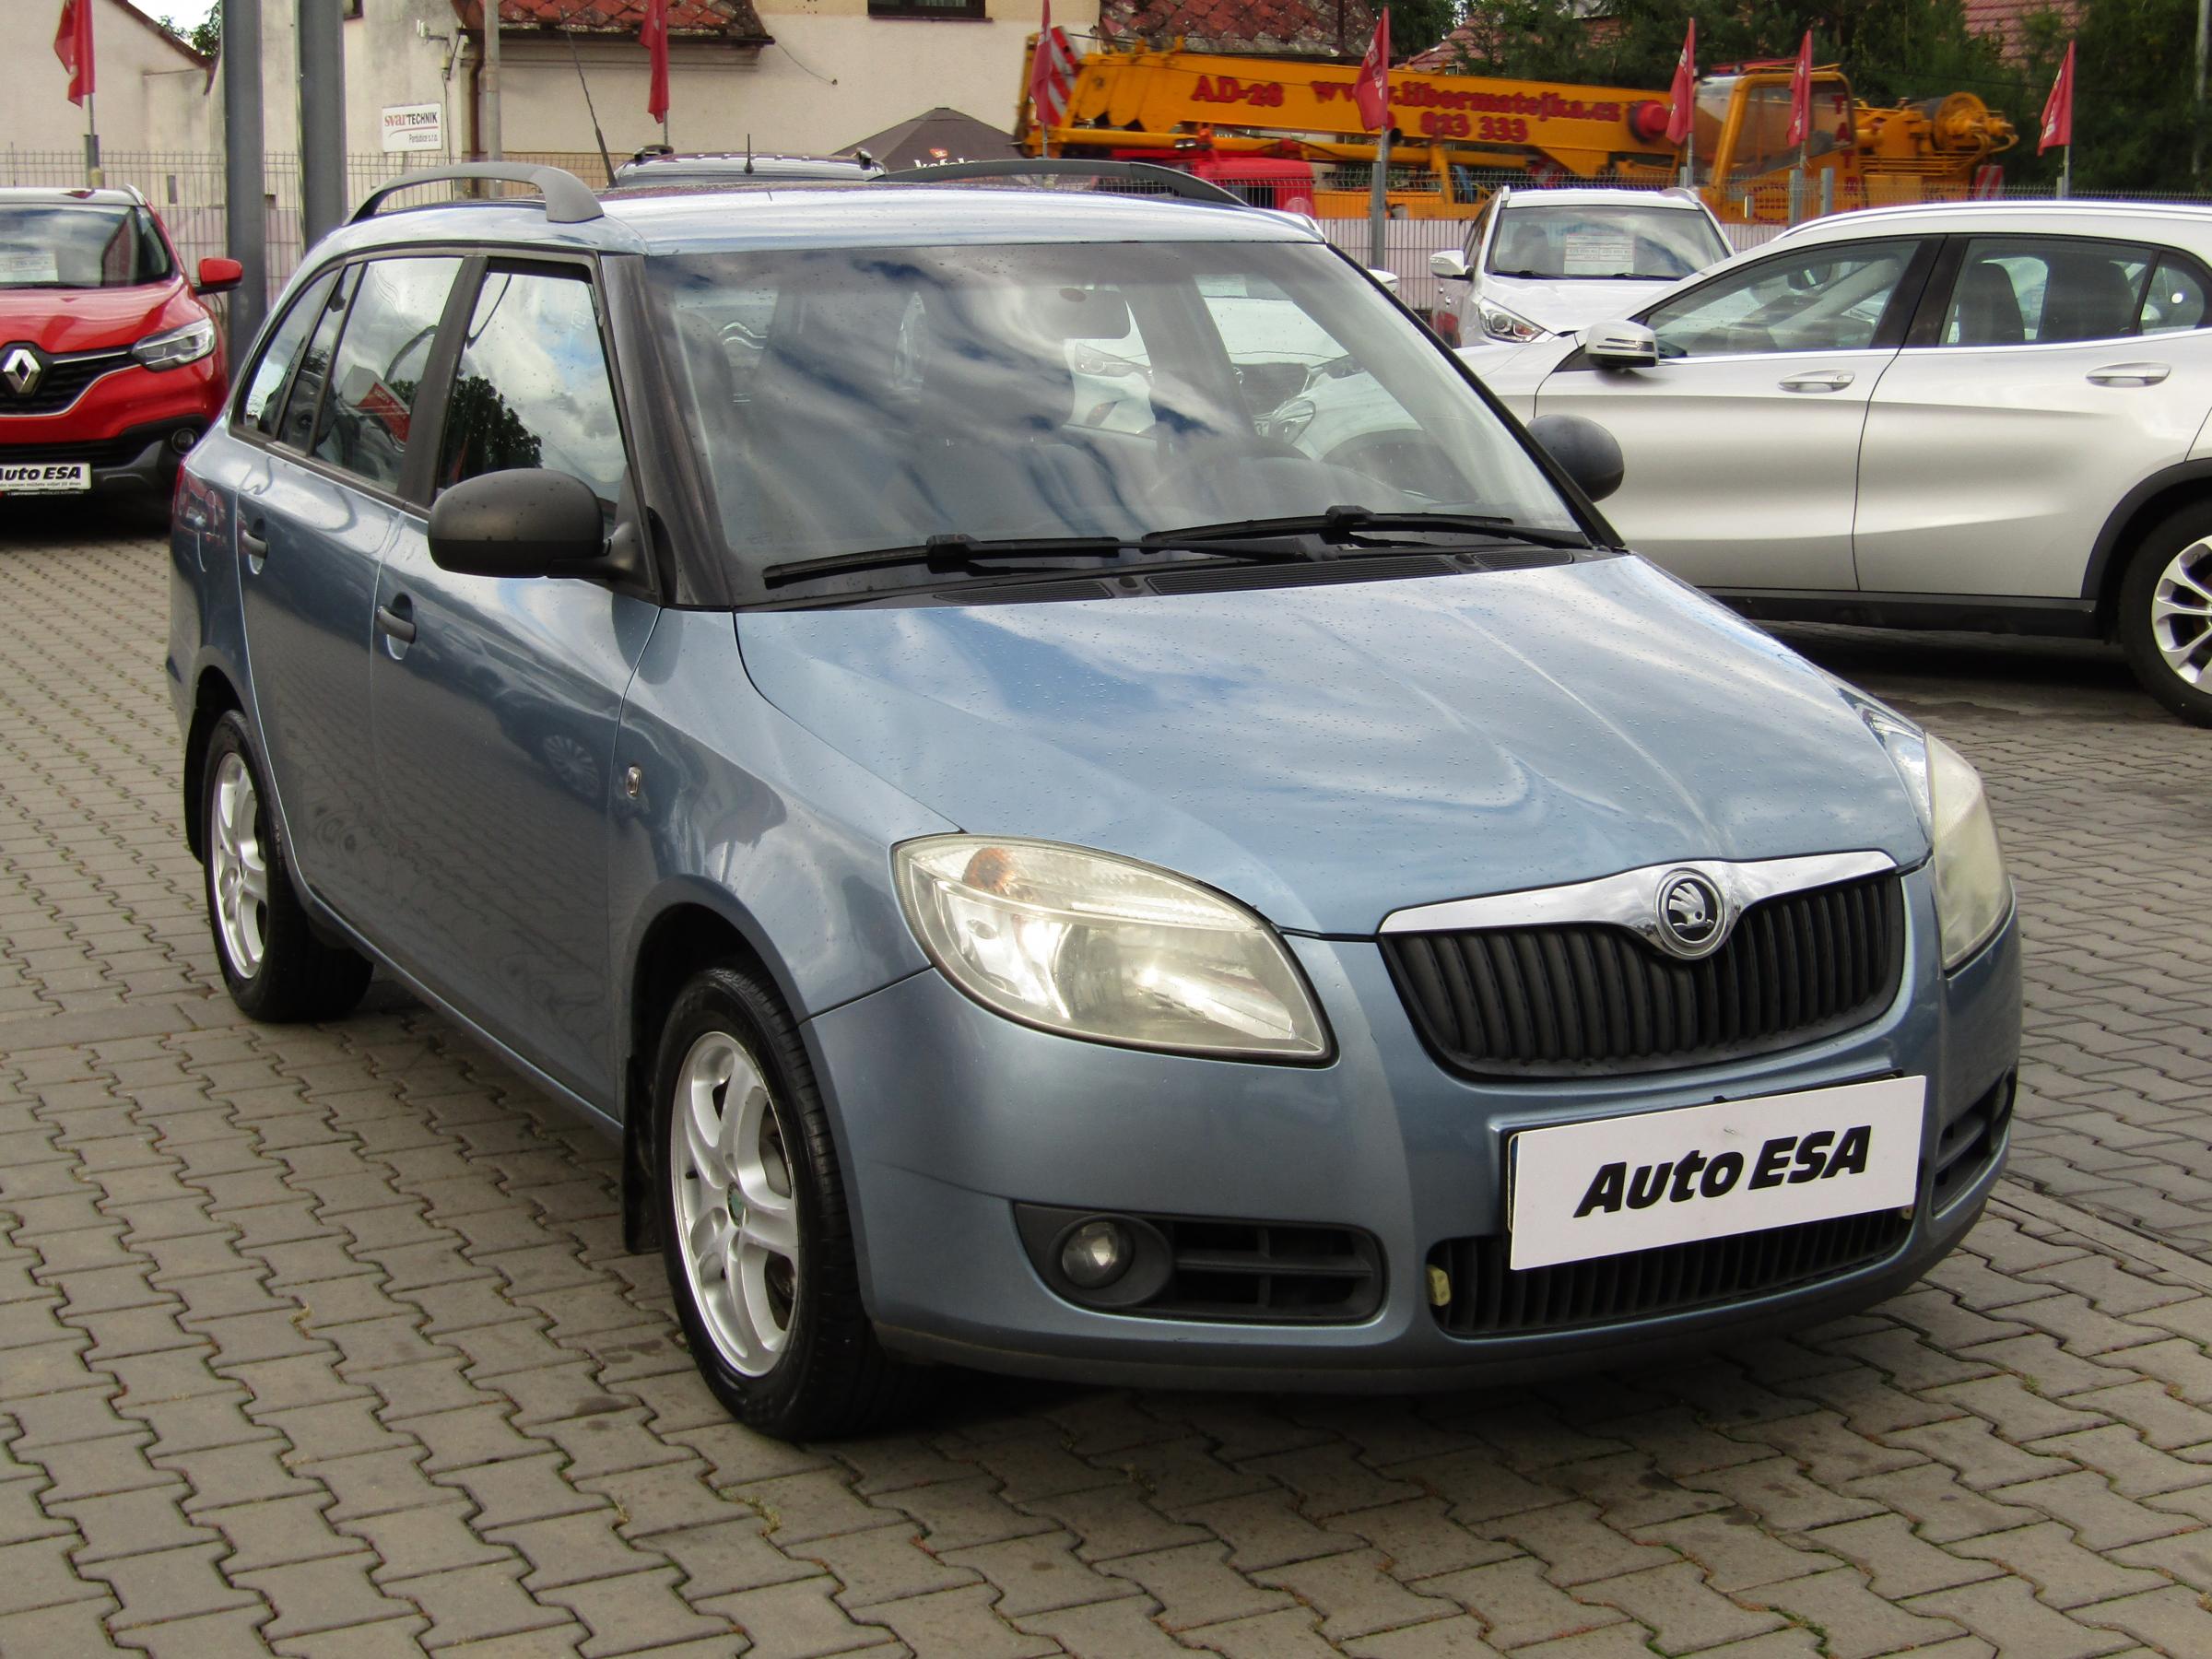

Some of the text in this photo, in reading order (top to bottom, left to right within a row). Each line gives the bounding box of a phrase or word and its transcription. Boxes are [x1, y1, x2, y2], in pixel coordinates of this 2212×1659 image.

[1310, 80, 1620, 122] ww.libormatejka.cz
[1478, 116, 1528, 142] 333
[0, 466, 81, 480] uto ESA
[1573, 1125, 1872, 1218] Auto ESA
